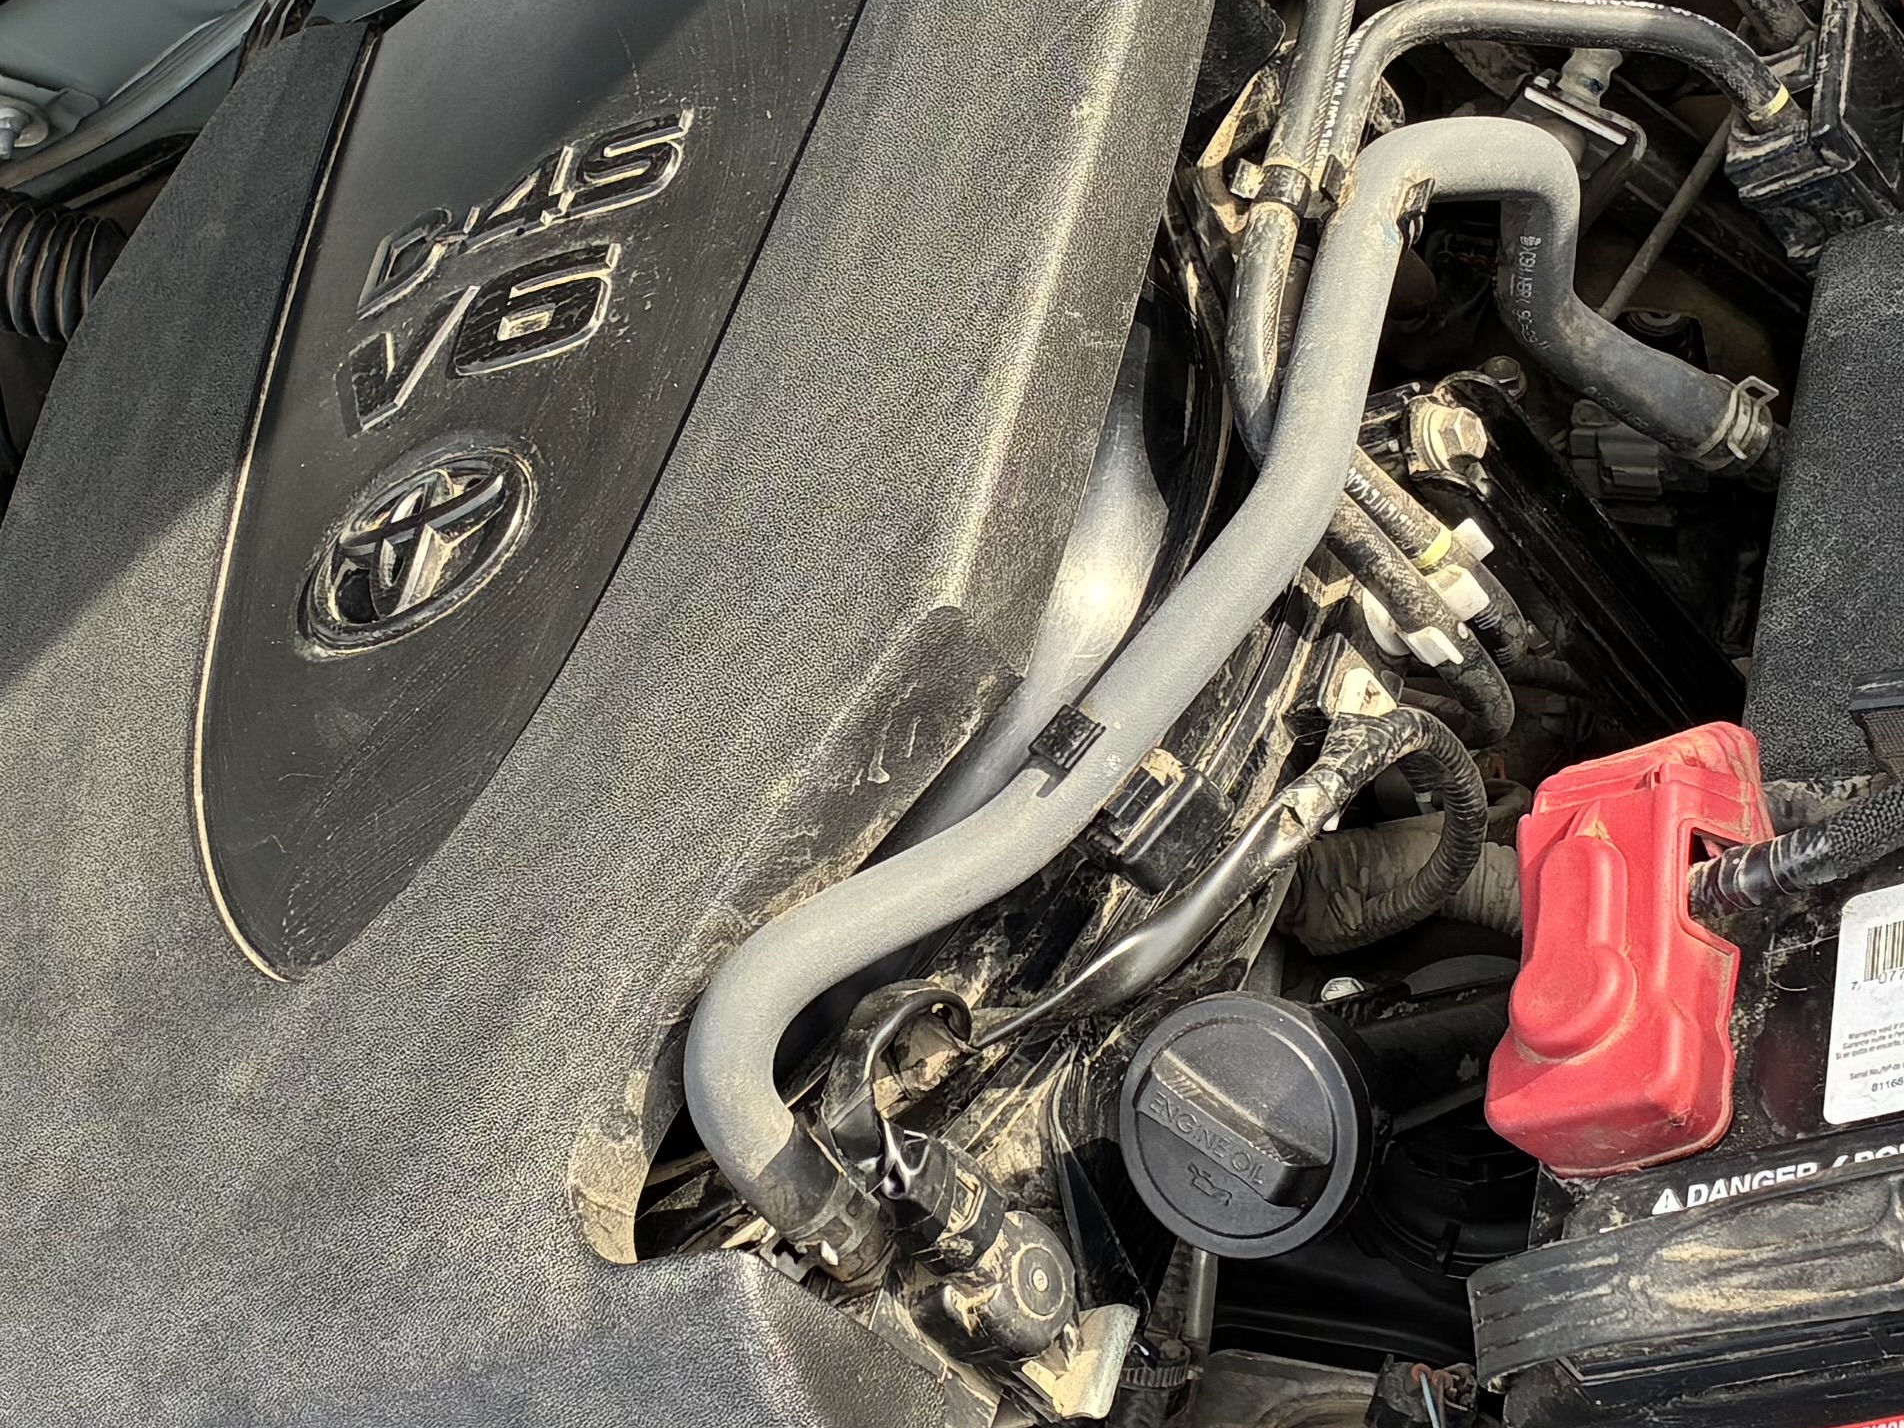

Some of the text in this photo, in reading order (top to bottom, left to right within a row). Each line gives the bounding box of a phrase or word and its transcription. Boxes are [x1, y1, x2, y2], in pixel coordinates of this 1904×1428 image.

[334, 242, 623, 436] V6
[1149, 1091, 1265, 1185] ENGINE OIL
